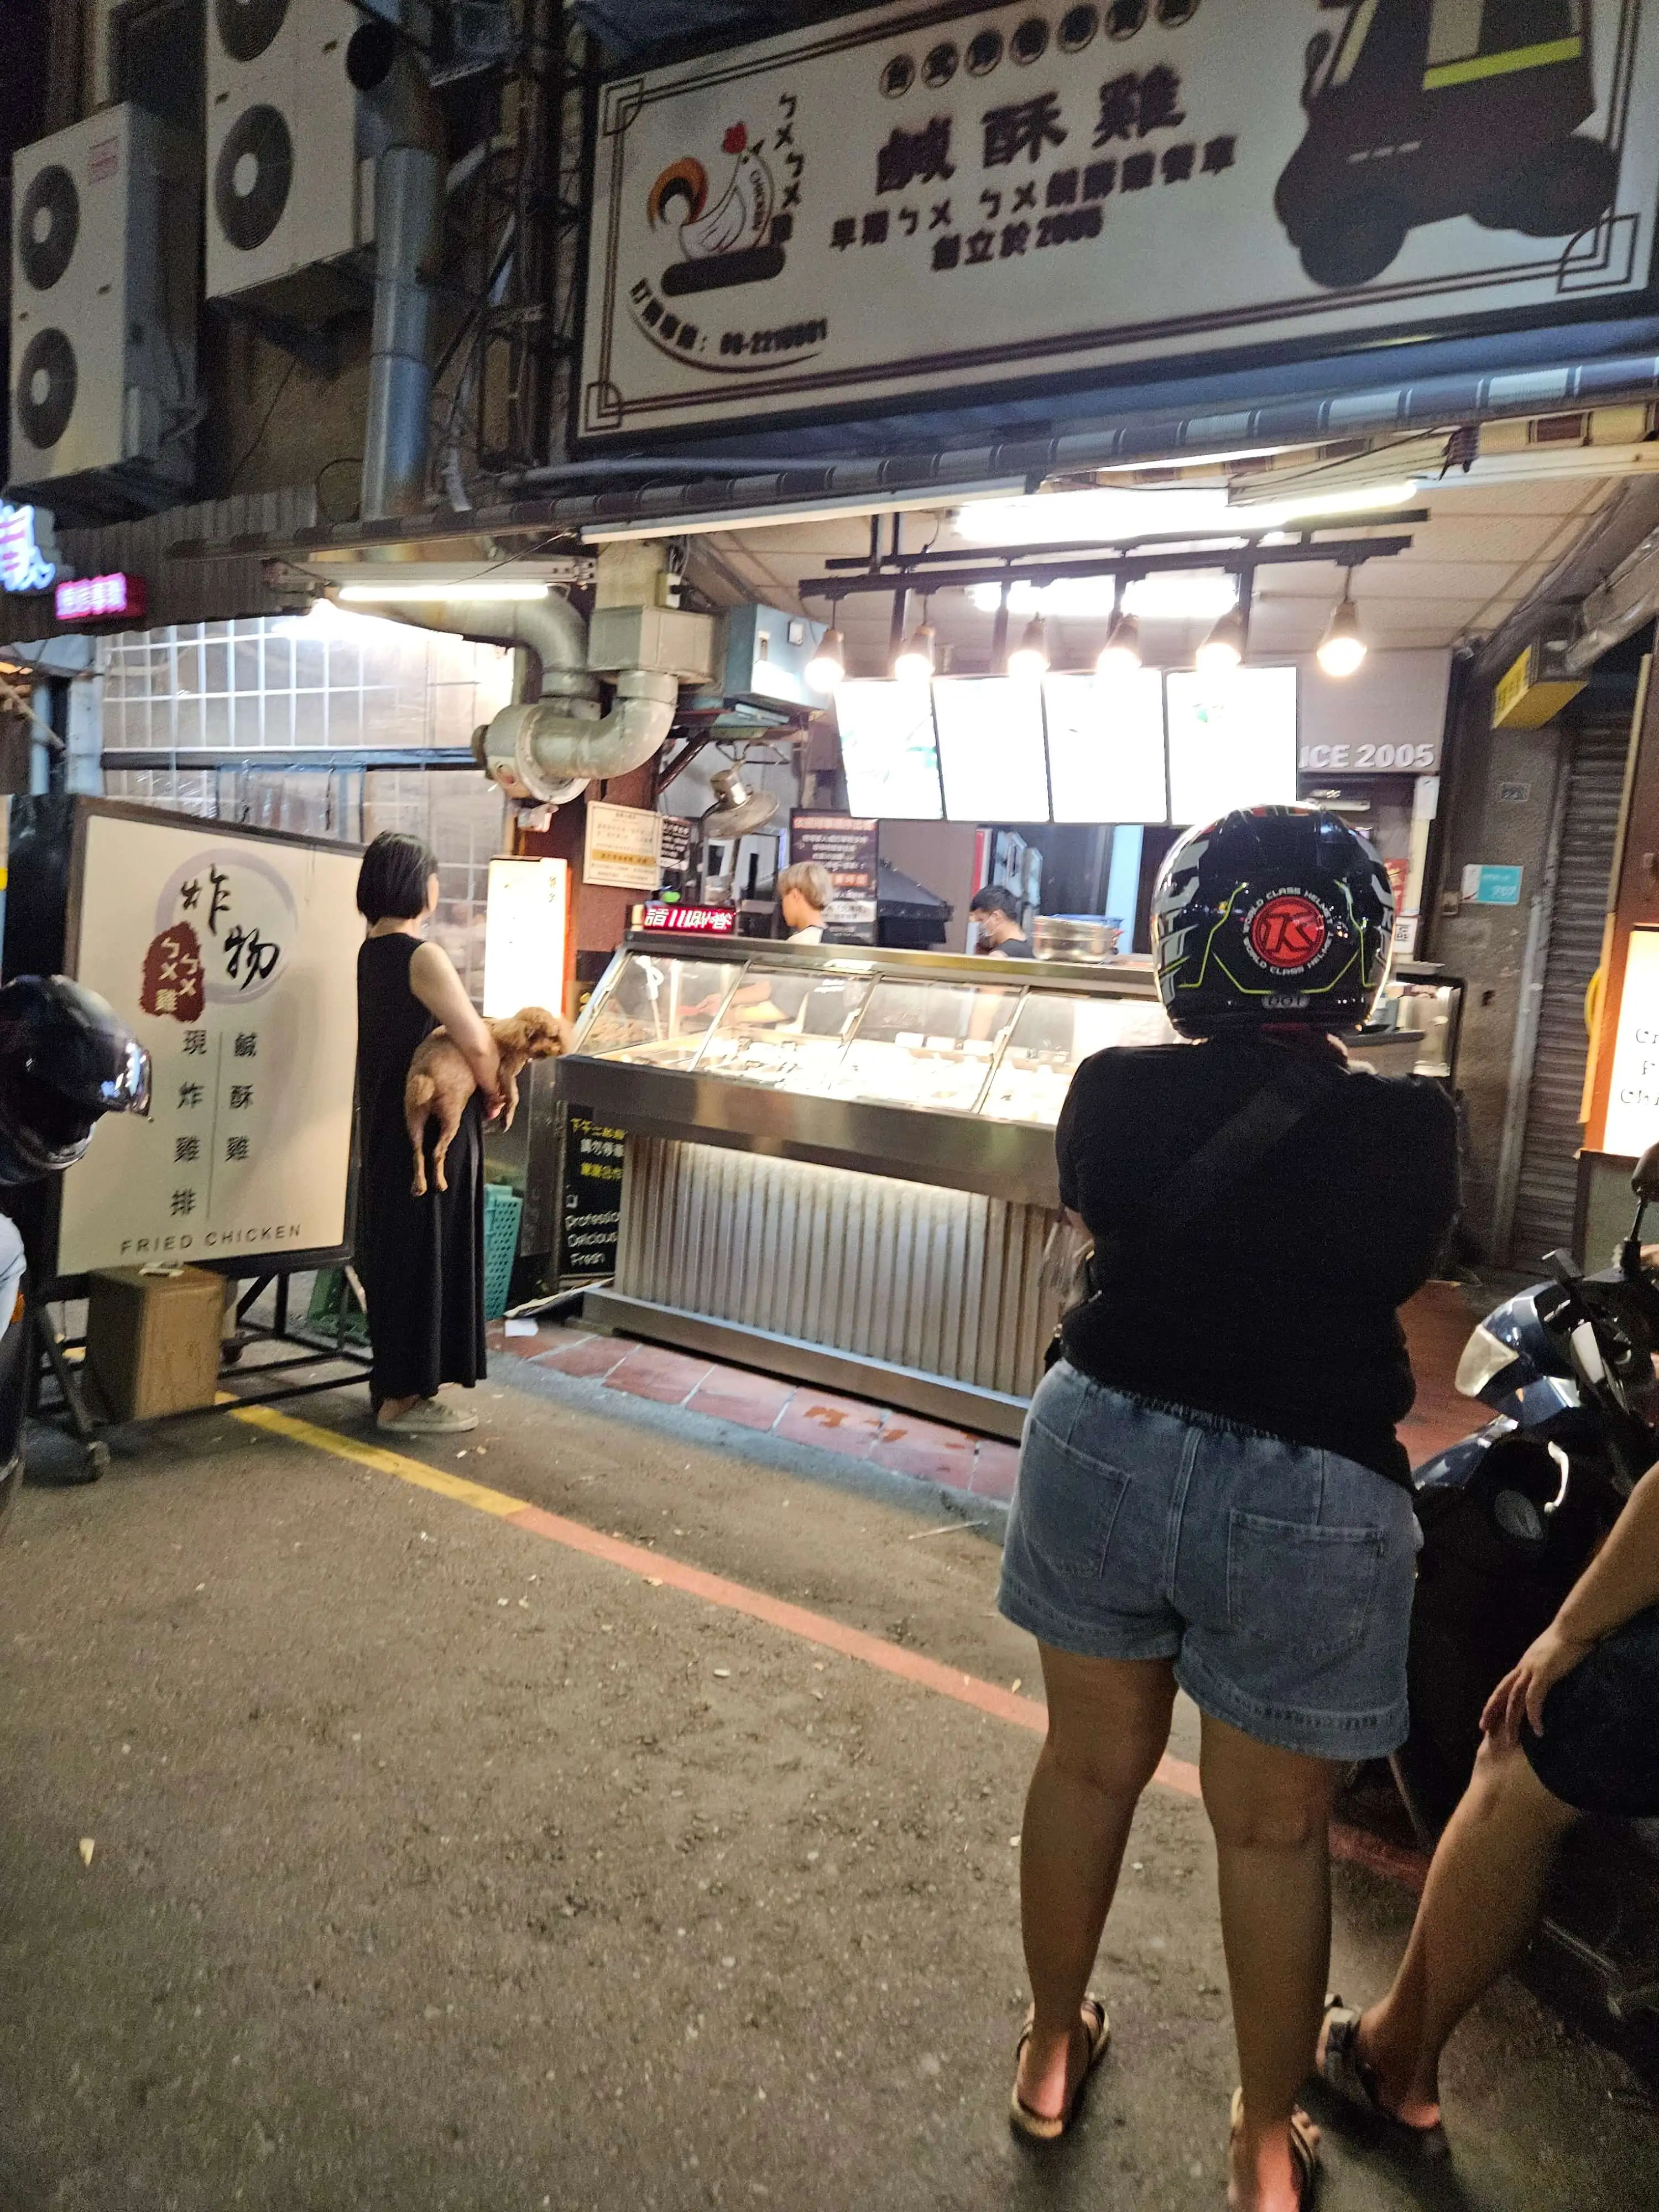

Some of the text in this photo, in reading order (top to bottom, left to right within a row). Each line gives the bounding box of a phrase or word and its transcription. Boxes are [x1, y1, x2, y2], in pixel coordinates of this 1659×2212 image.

[1355, 743, 1436, 768] 2005
[171, 1030, 207, 1215] 現炸雞排
[225, 1032, 258, 1162] 鹹酥雞
[120, 1219, 301, 1256] FRIED CHICKEN
